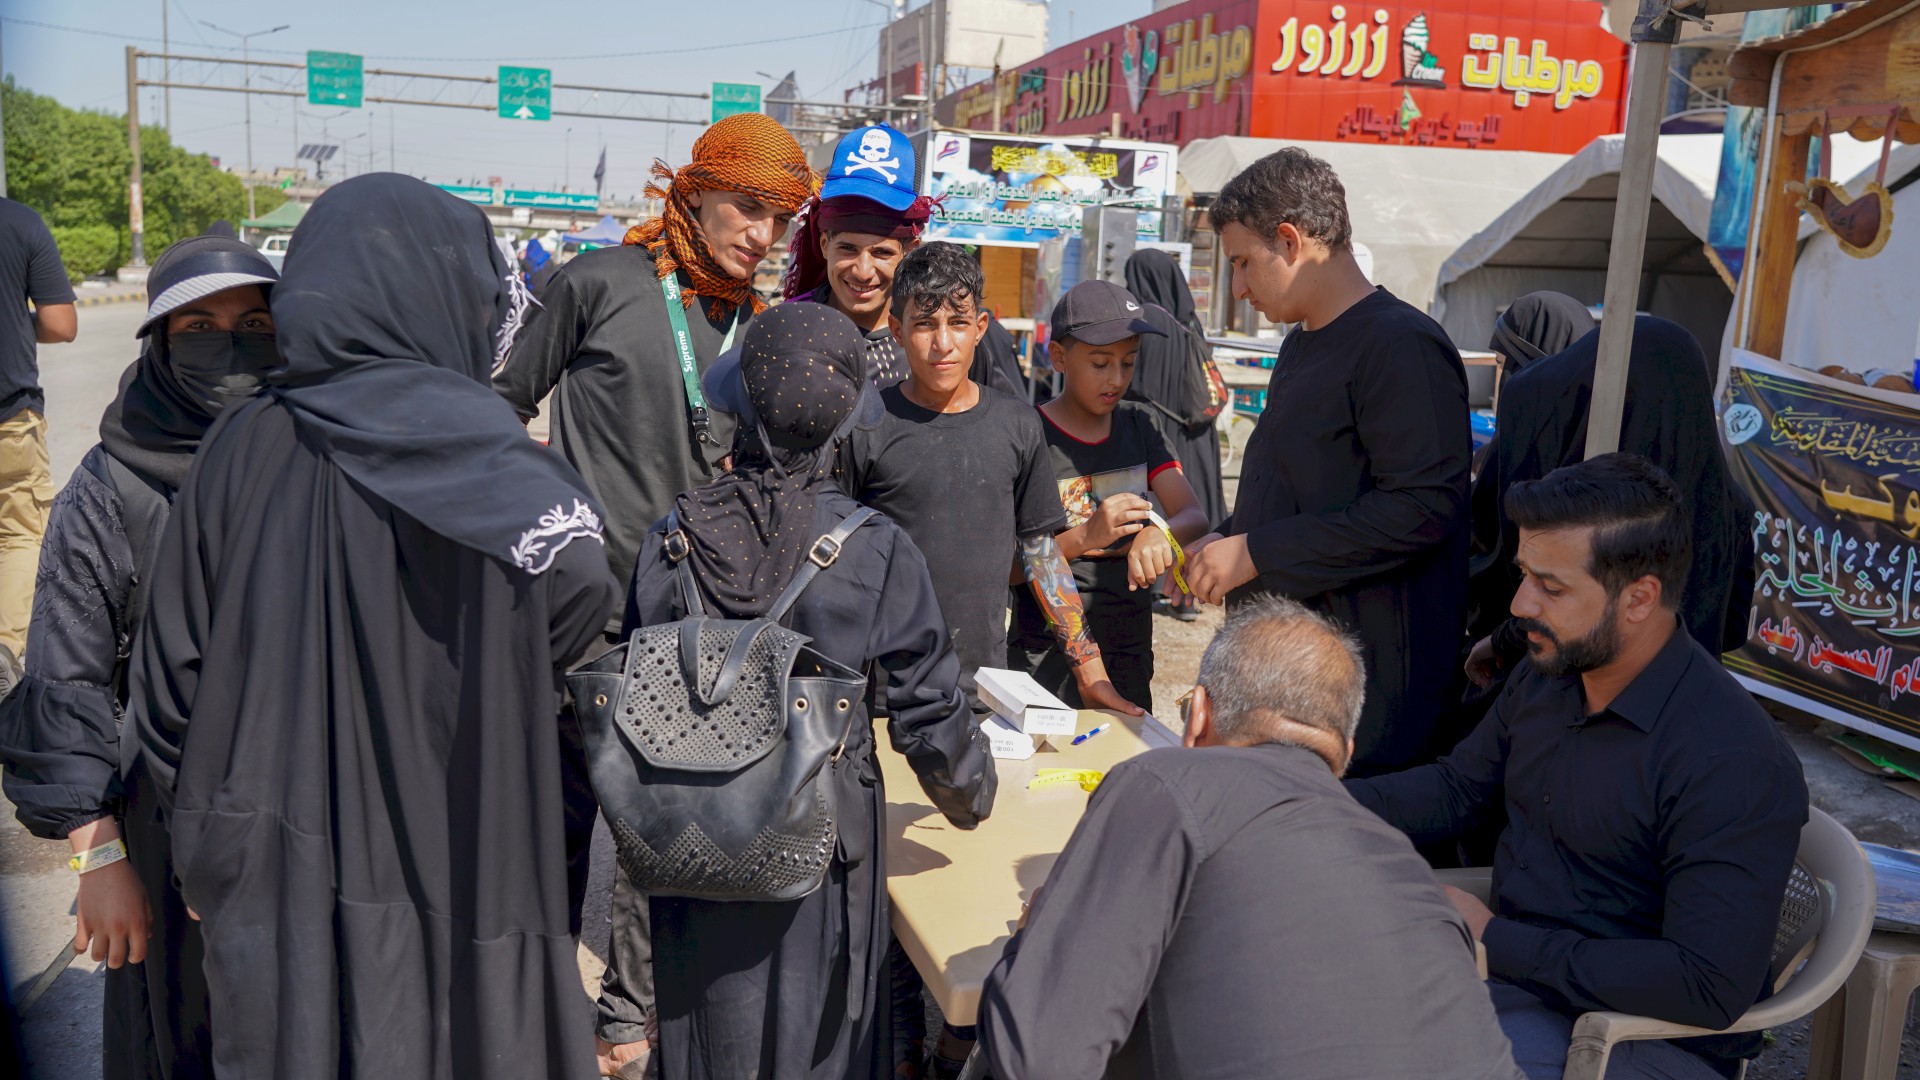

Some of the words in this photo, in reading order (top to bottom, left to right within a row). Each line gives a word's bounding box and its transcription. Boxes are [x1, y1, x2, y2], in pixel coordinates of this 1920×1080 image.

[1159, 12, 1252, 110] مرطبات
[1271, 4, 1390, 79] زرزور
[1461, 33, 1604, 110] مرطبات
[1056, 41, 1114, 124] زرزور
[677, 330, 693, 373] Supreme
[1820, 473, 1920, 539] وكب
[1808, 634, 1893, 685] الحسين
